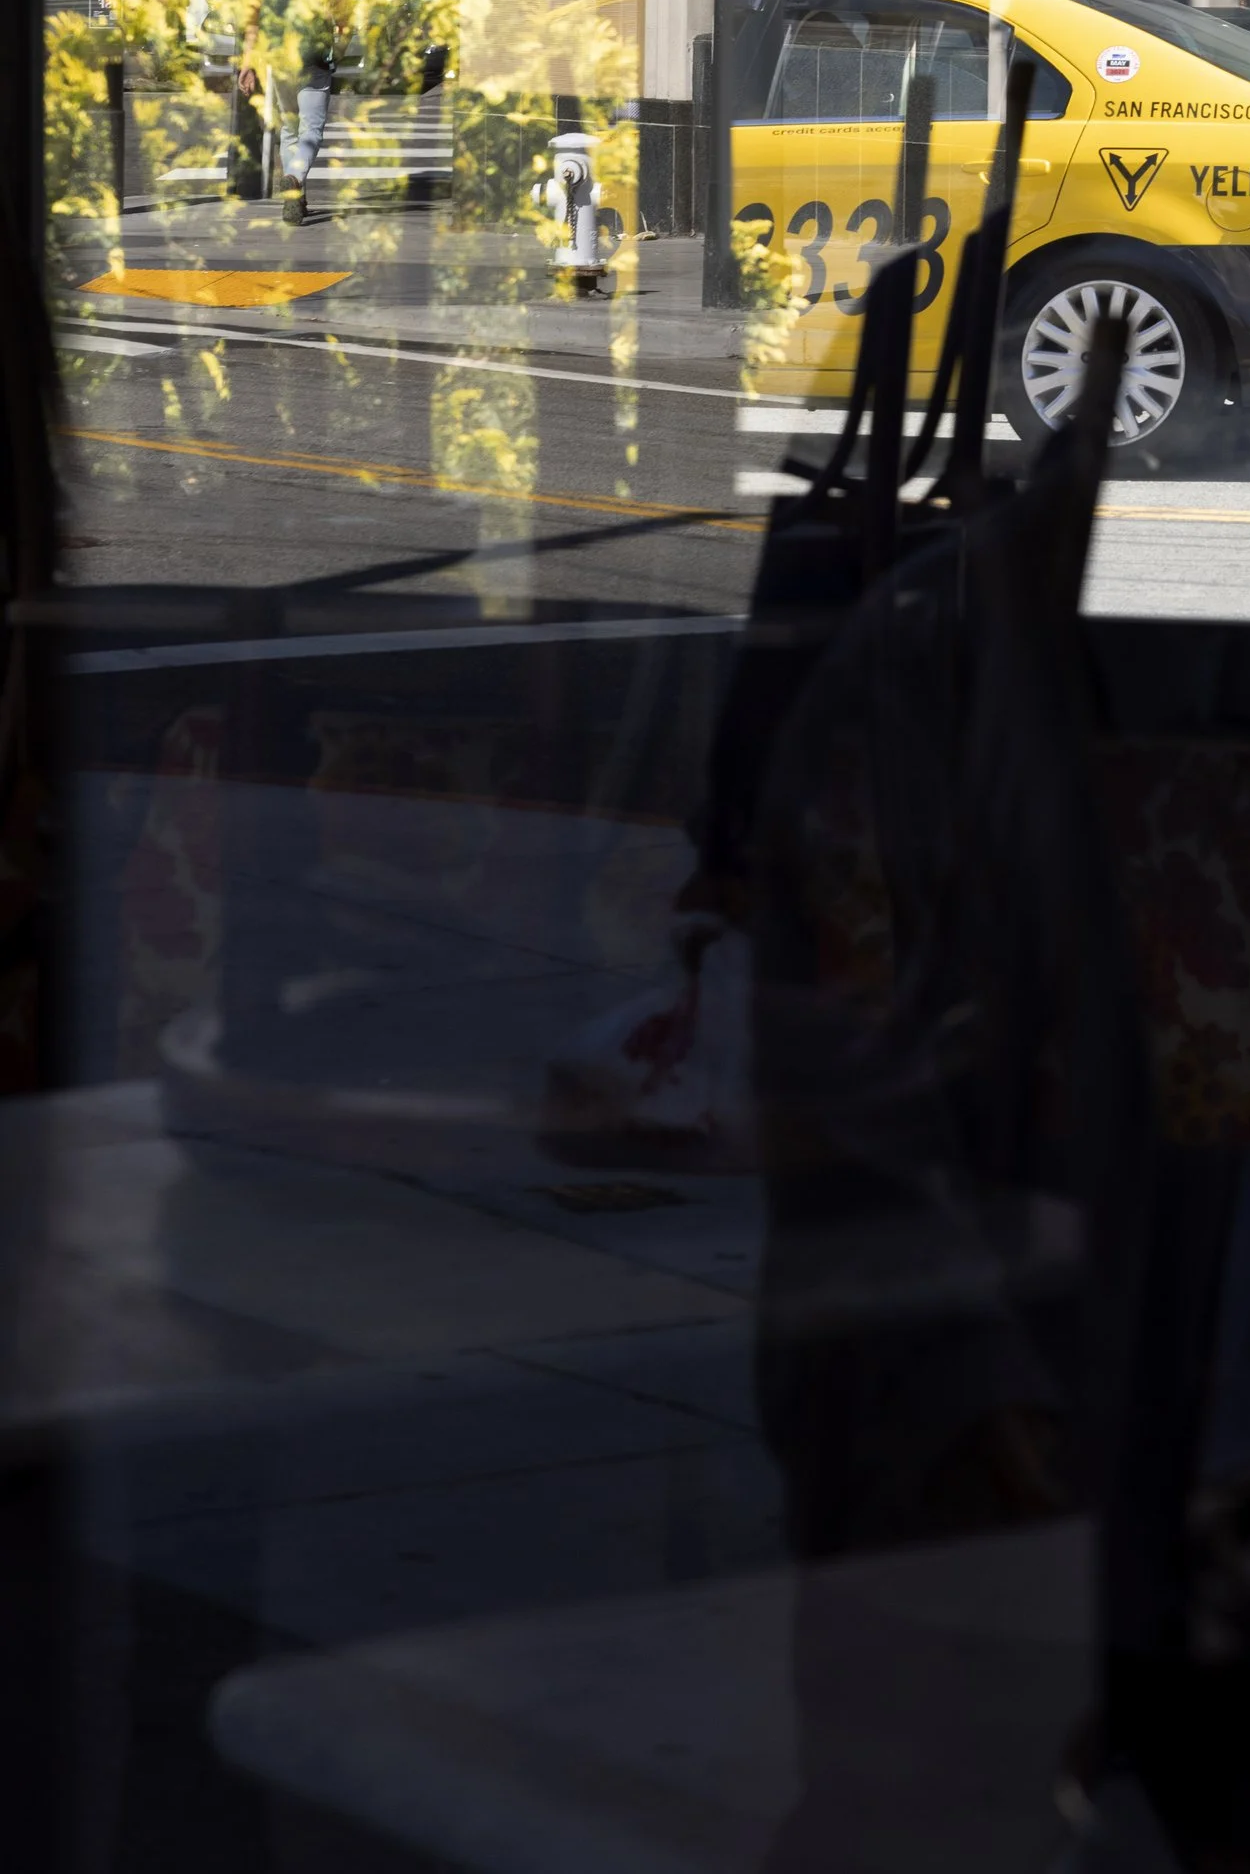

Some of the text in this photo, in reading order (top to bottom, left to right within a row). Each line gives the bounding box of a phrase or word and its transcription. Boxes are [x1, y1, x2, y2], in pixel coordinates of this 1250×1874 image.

[1104, 101, 1143, 118] SAN
[772, 127, 815, 136] credit
[819, 125, 860, 134] cards
